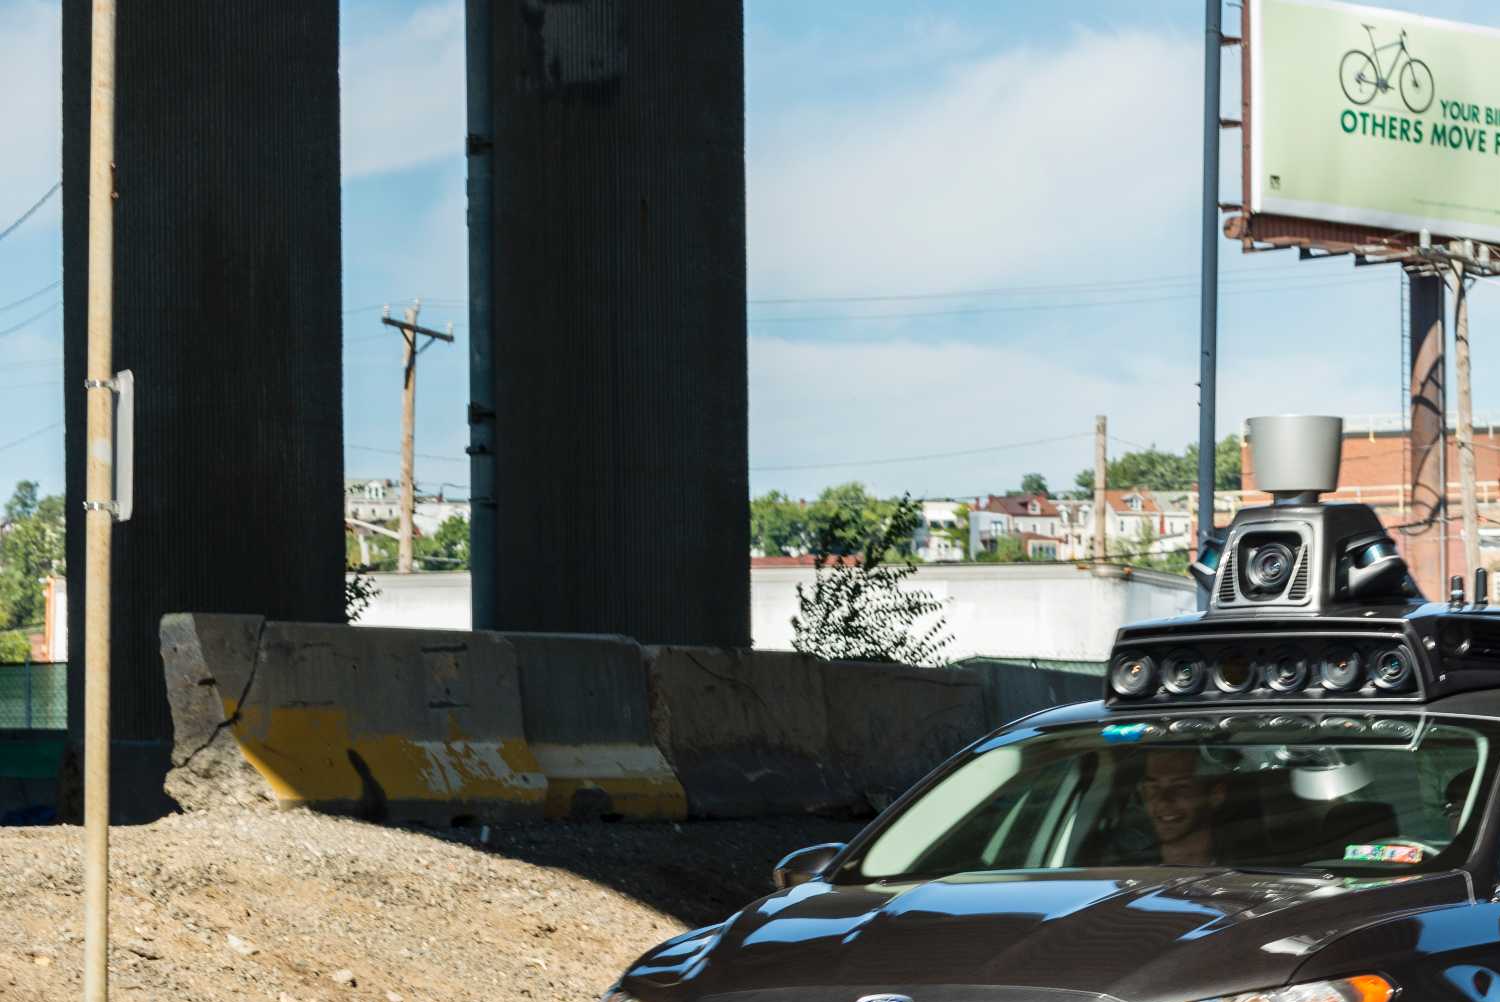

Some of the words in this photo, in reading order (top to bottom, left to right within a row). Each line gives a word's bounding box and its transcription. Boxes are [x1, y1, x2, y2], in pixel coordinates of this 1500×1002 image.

[1440, 100, 1480, 124] YOUR
[1340, 109, 1423, 144] OTHERS
[1430, 123, 1487, 153] MOVE
